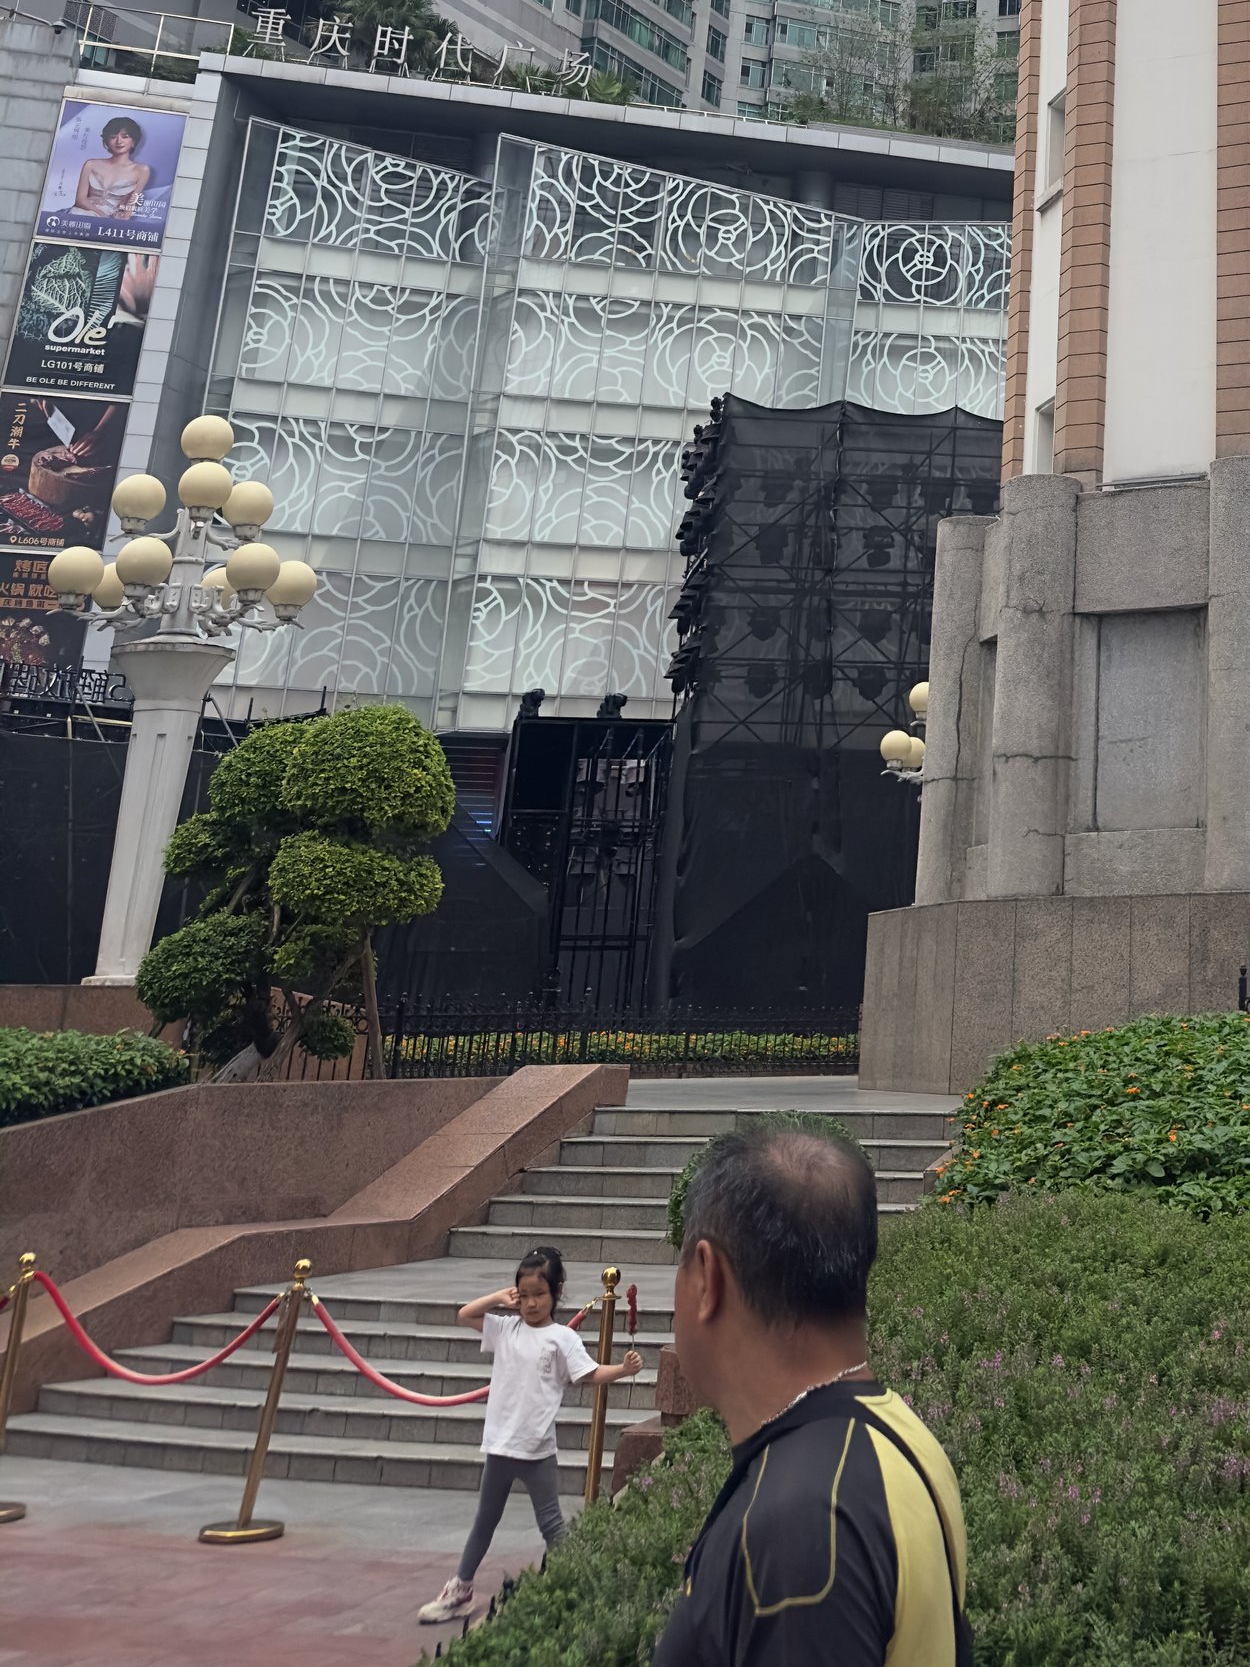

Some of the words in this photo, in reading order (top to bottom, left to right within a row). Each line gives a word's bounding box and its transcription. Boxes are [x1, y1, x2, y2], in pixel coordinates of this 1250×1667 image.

[246, 7, 595, 88] 重庆时代广场
[44, 344, 106, 355] supermarket
[41, 359, 105, 373] LG101号商铺
[39, 377, 56, 385] OLE
[70, 380, 116, 390] DIFFERENT
[7, 402, 28, 450] 二刀潮牛
